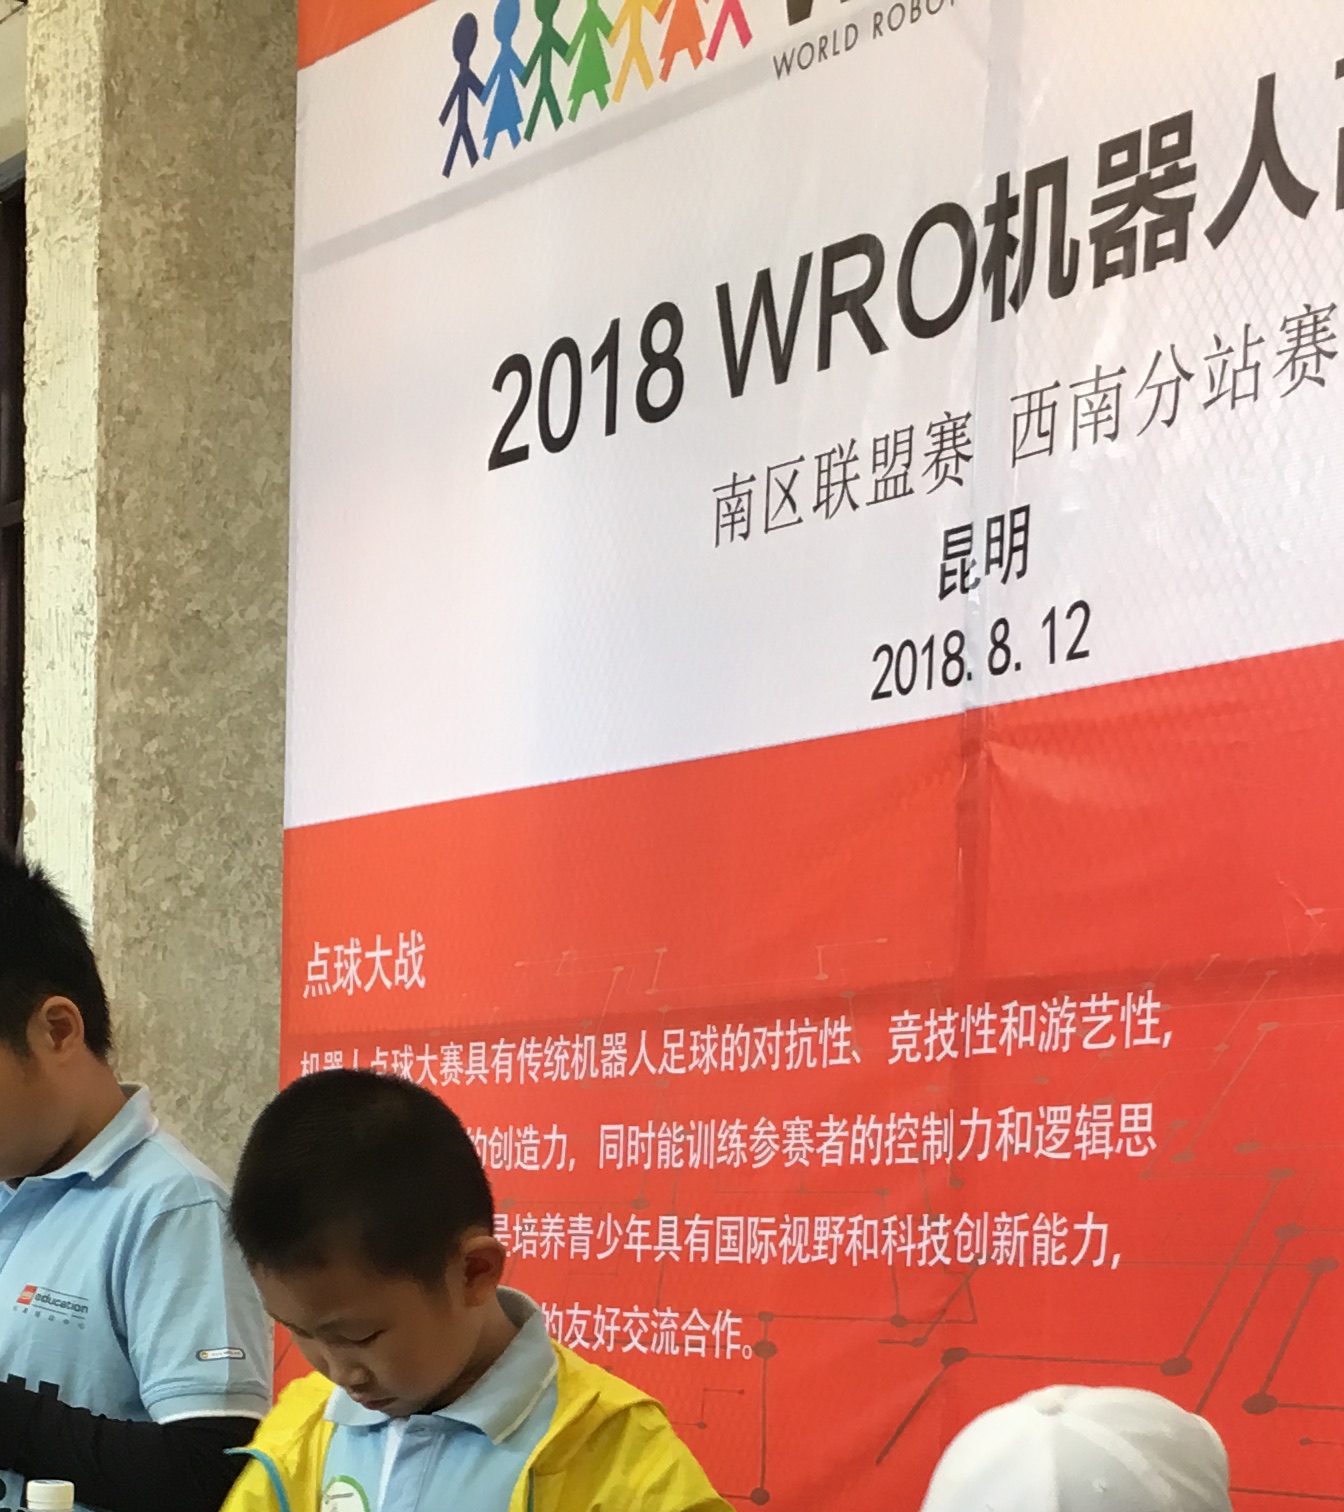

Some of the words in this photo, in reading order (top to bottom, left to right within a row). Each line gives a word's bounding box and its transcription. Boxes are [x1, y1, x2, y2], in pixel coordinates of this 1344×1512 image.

[773, 23, 859, 80] WORLD
[872, 0, 956, 39] ROBO
[488, 301, 685, 471] 2018
[712, 411, 975, 549] 南区联盟赛
[1010, 301, 1340, 468] 西南分站赛
[939, 505, 1033, 602] 昆明
[303, 929, 426, 998] 点球大战
